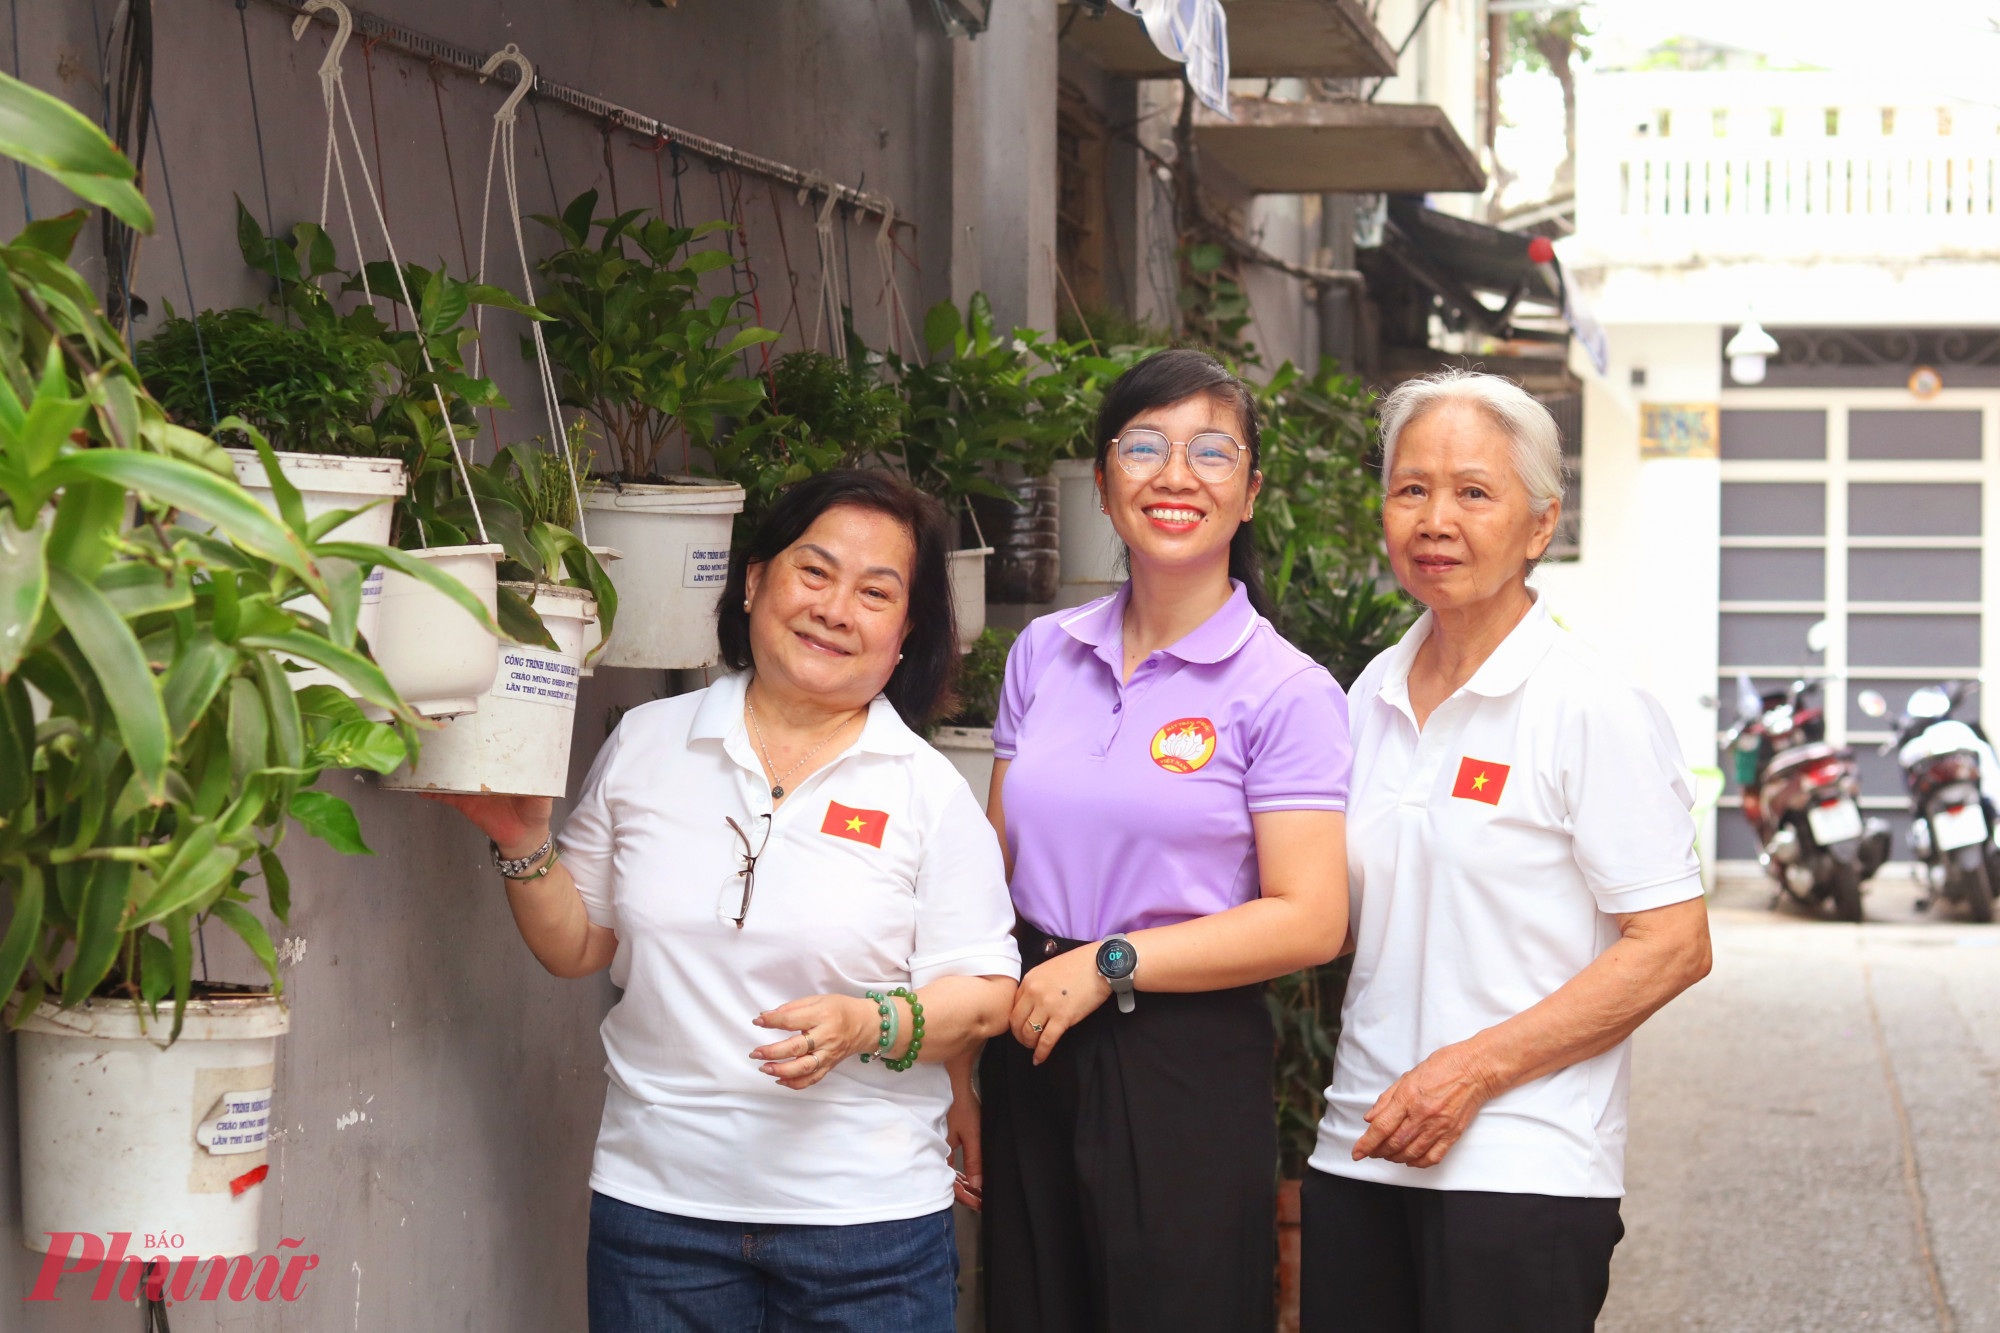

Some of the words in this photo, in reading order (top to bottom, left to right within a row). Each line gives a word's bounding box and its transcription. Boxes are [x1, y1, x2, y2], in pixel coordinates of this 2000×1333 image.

[504, 654, 524, 667] CÔNG
[526, 658, 544, 670] TRÌNH
[510, 672, 530, 681] CHÀO
[532, 674, 551, 684] MỪNG
[506, 682, 521, 692] LẦN
[522, 685, 536, 694] THỨ
[1109, 952, 1122, 961] 40
[216, 1121, 237, 1130] CHÀO
[212, 1135, 228, 1145] LẦN
